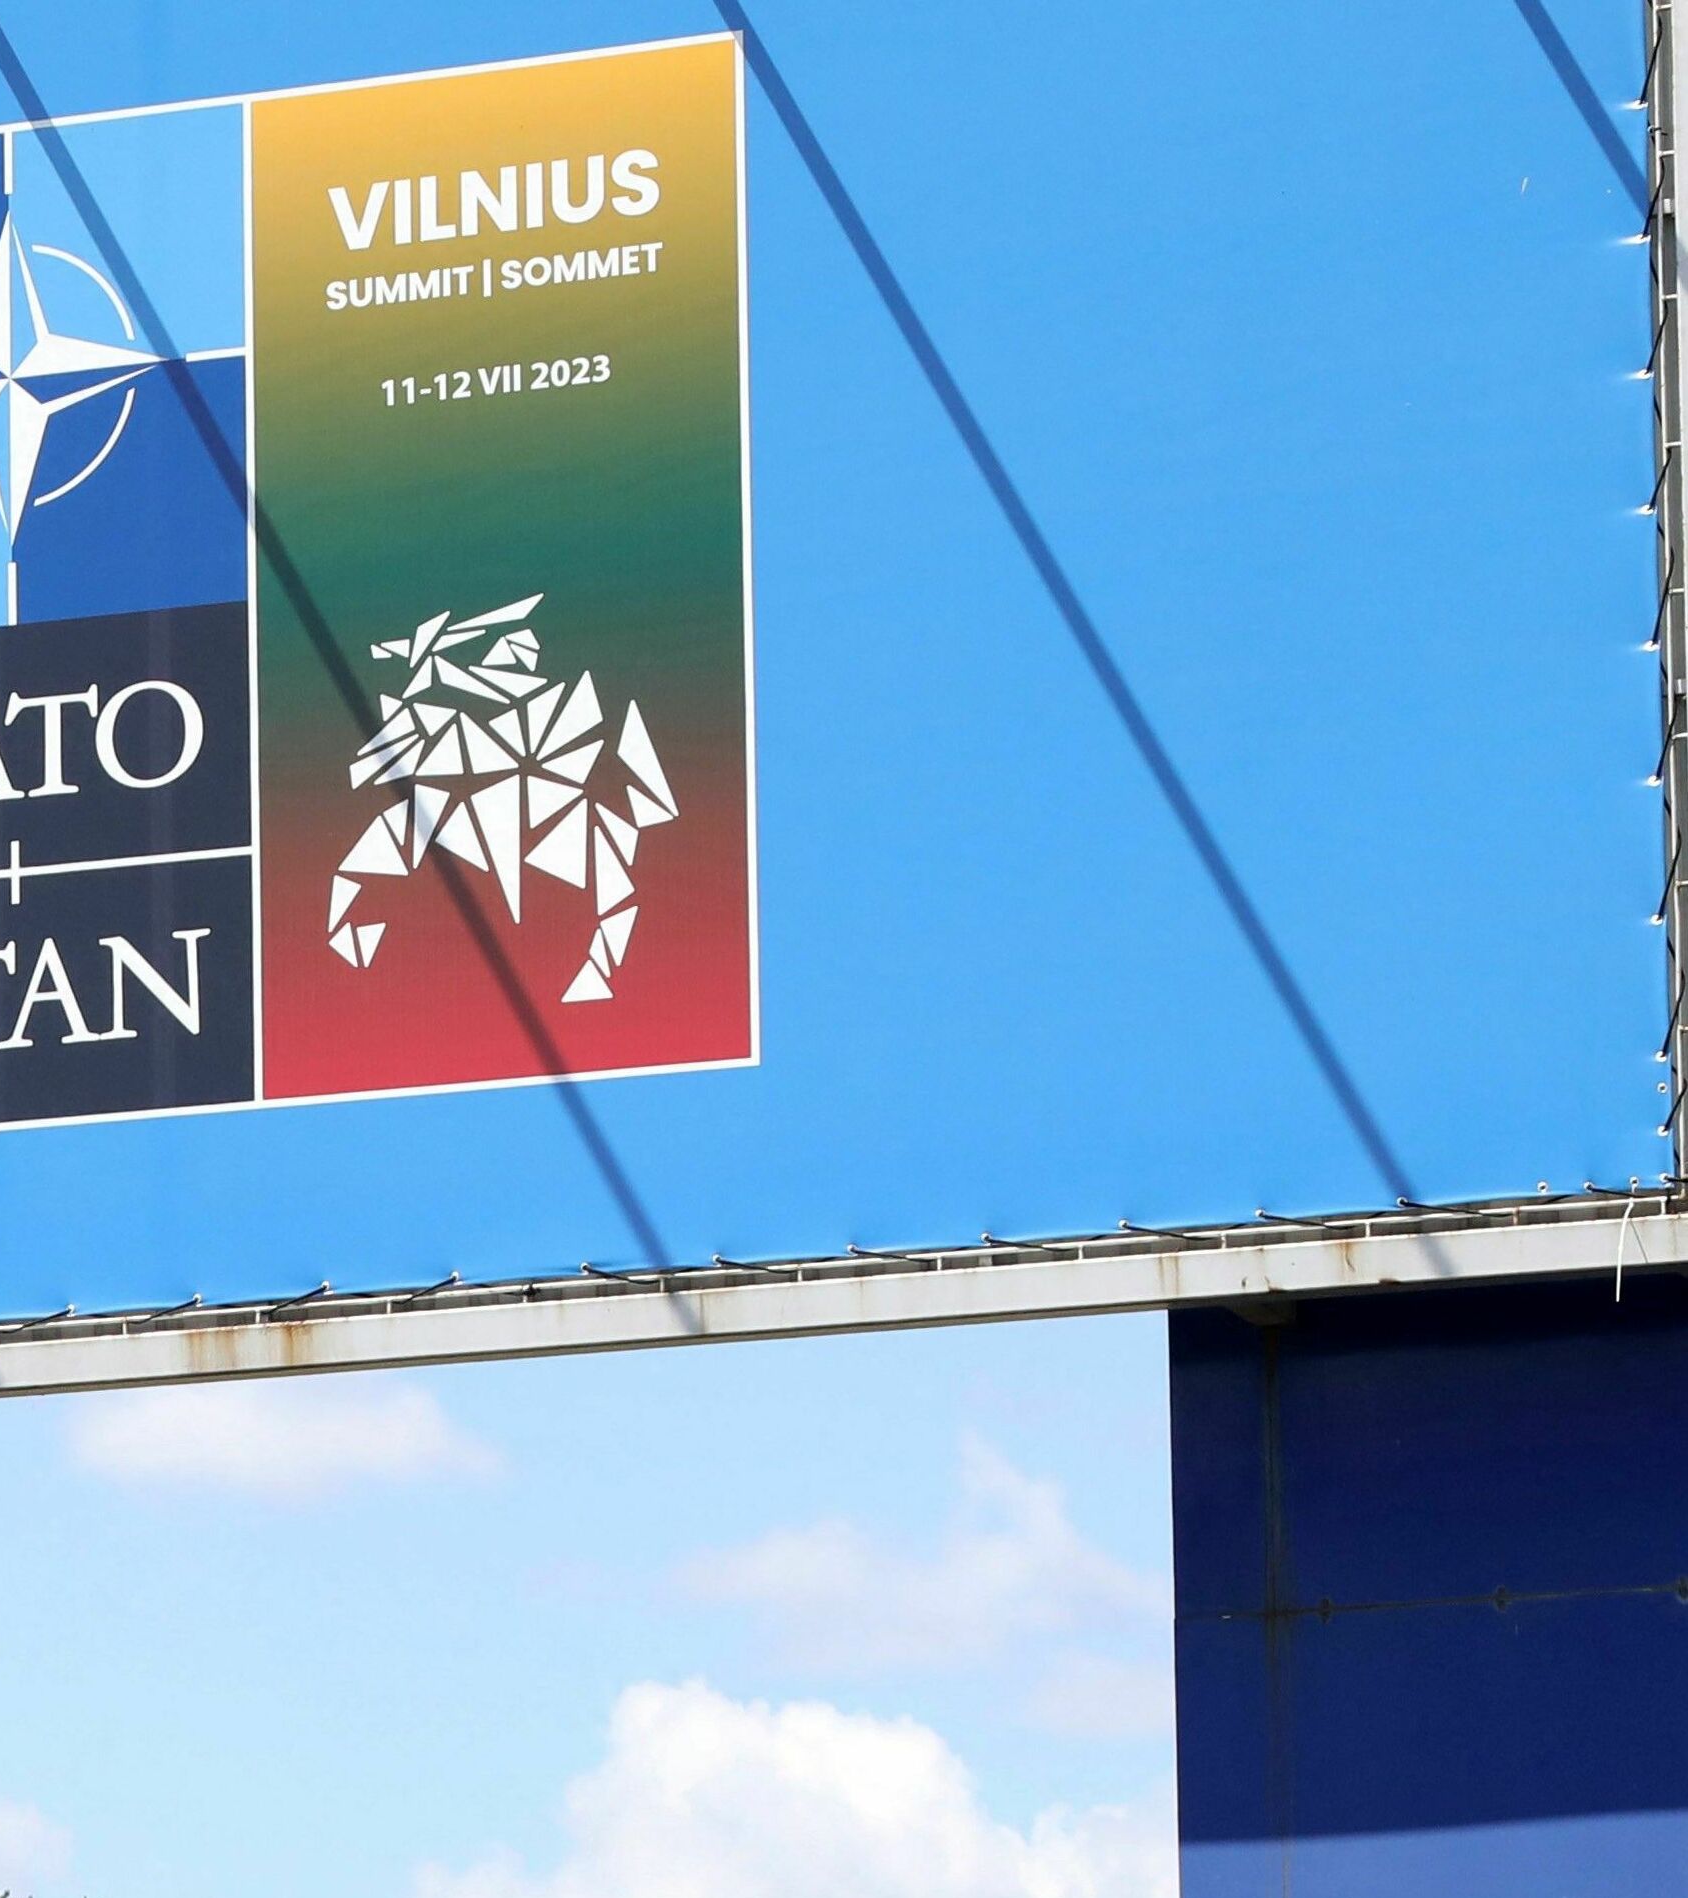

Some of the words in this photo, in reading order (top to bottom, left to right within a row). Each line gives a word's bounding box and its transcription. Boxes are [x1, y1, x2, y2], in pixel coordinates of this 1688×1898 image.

[328, 149, 660, 251] VILNIUS
[325, 265, 475, 311] SUMMIT
[500, 242, 663, 290] SOMMET
[380, 366, 472, 407] 11-12
[477, 362, 524, 397] VII
[529, 354, 611, 394] 2023
